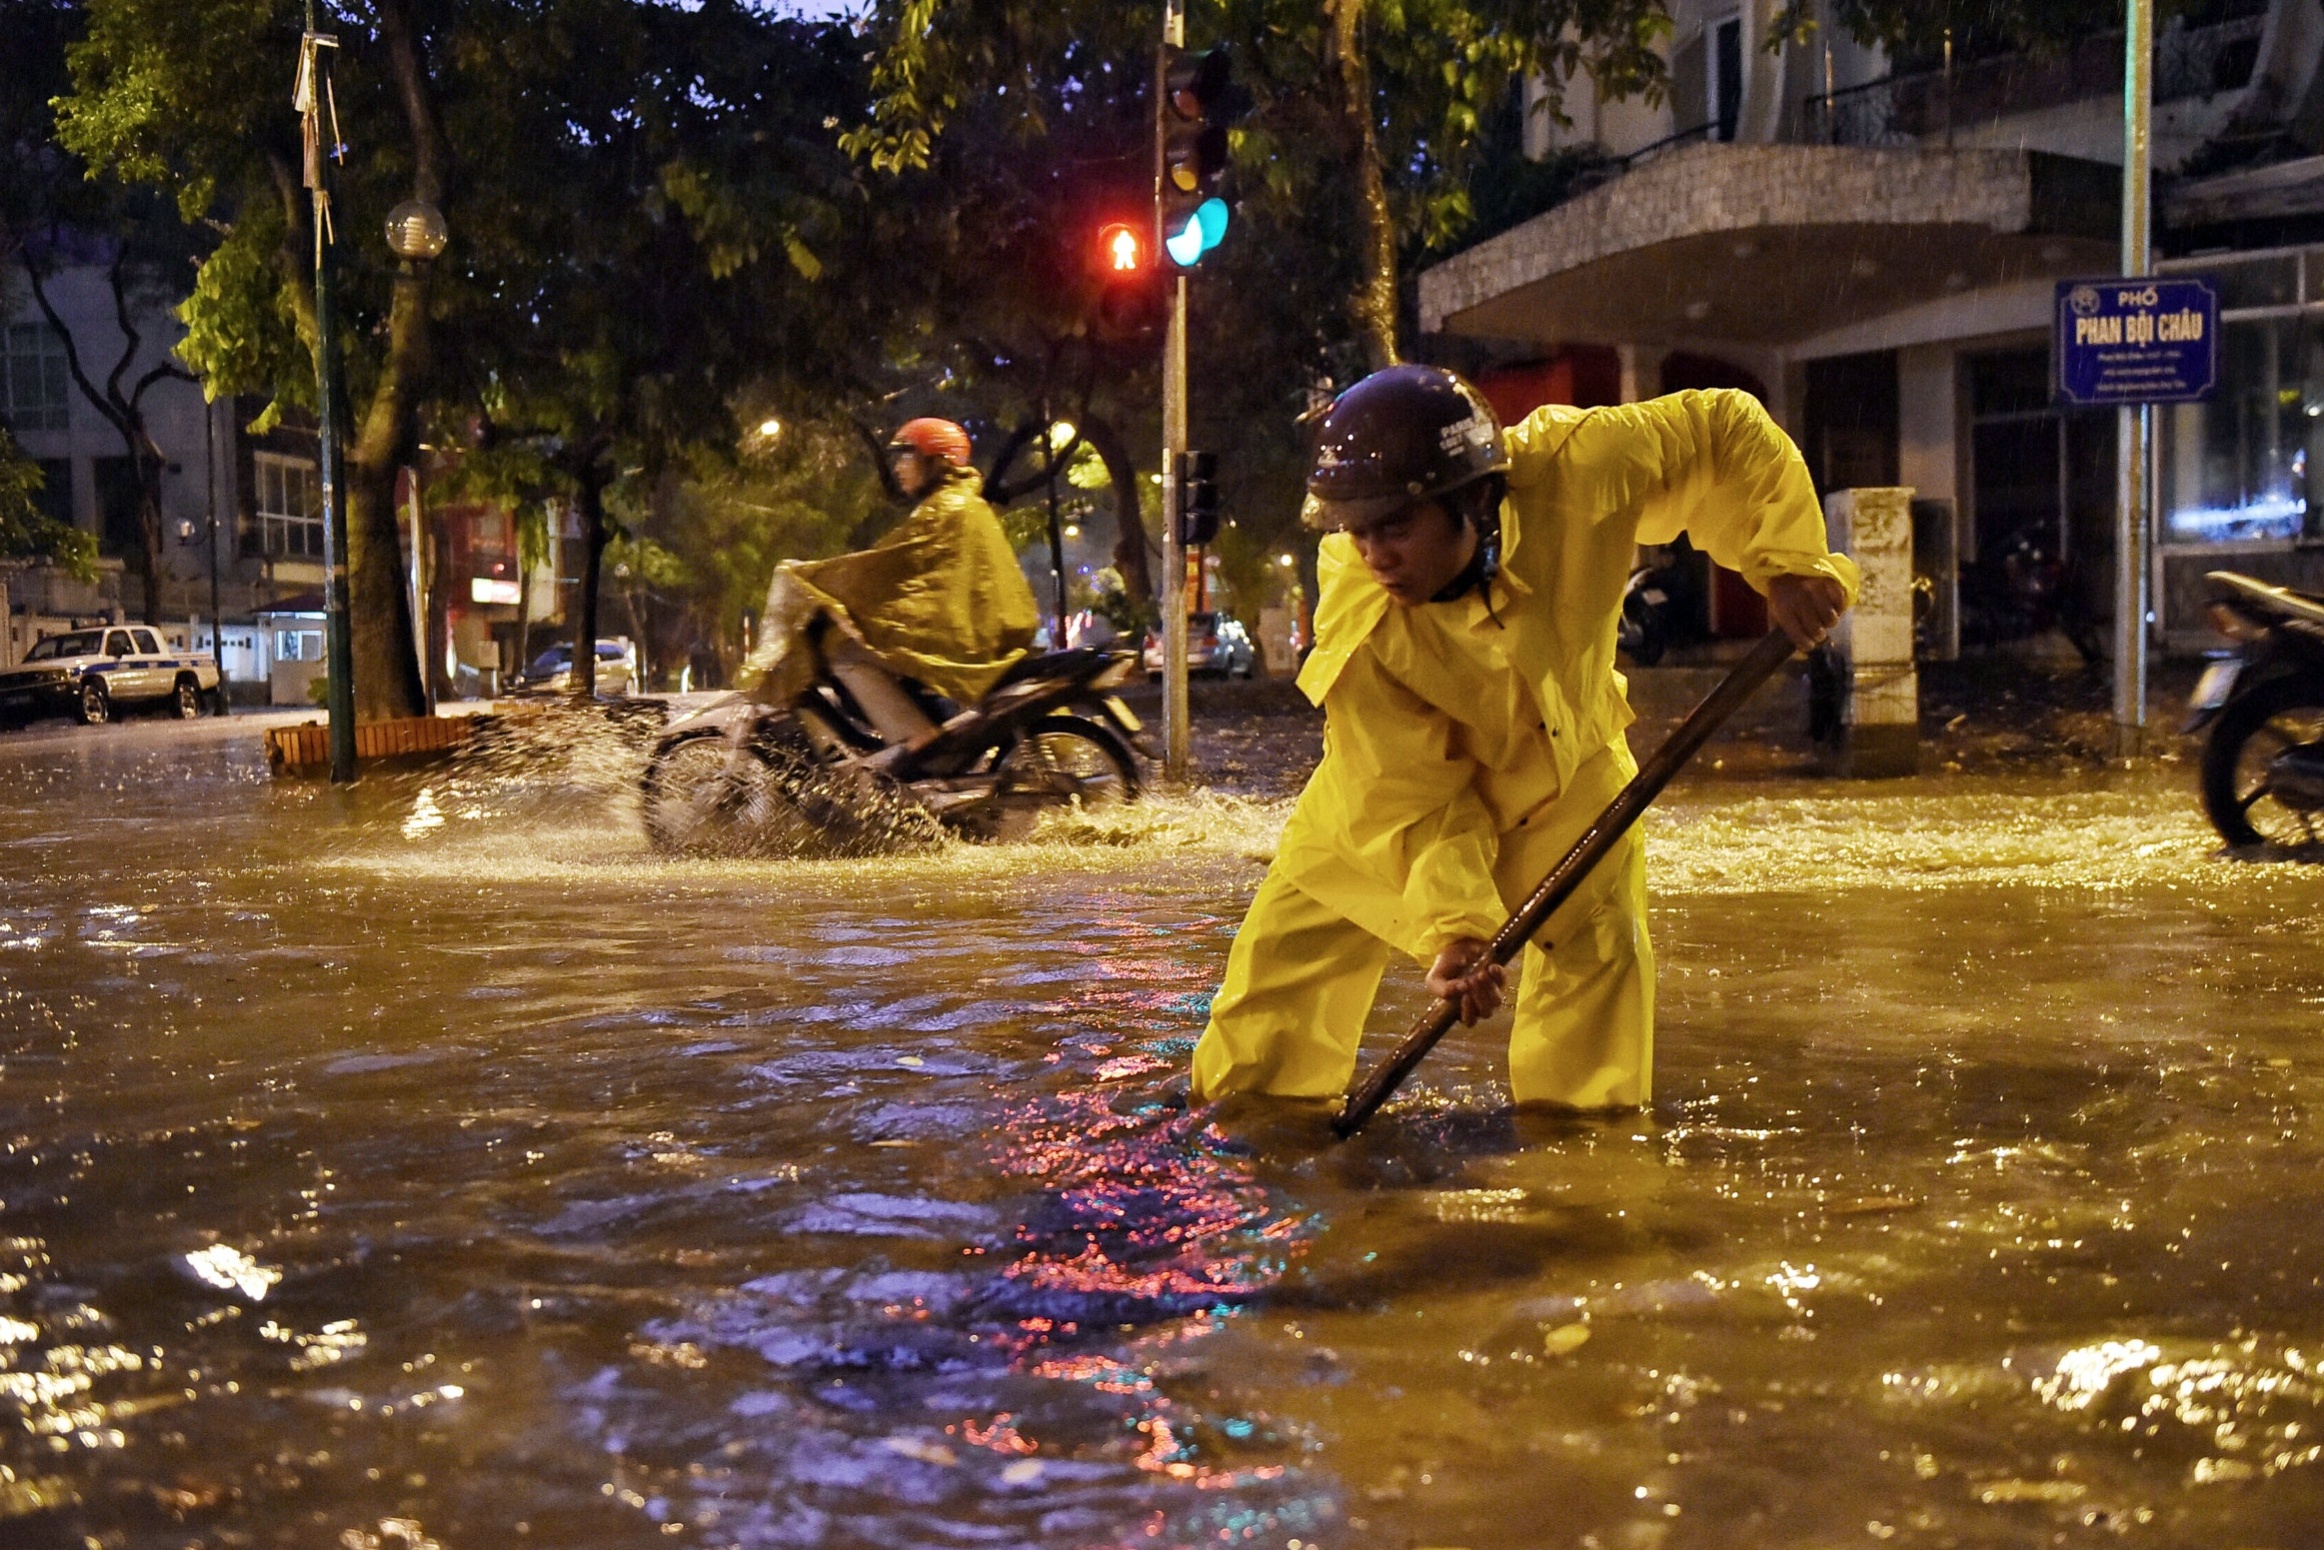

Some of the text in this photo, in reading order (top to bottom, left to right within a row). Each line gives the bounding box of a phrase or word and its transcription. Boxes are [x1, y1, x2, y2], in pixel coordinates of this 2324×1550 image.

[2118, 285, 2158, 307] PHỐ
[2076, 307, 2203, 348] PHAN BỘI CHÂU
